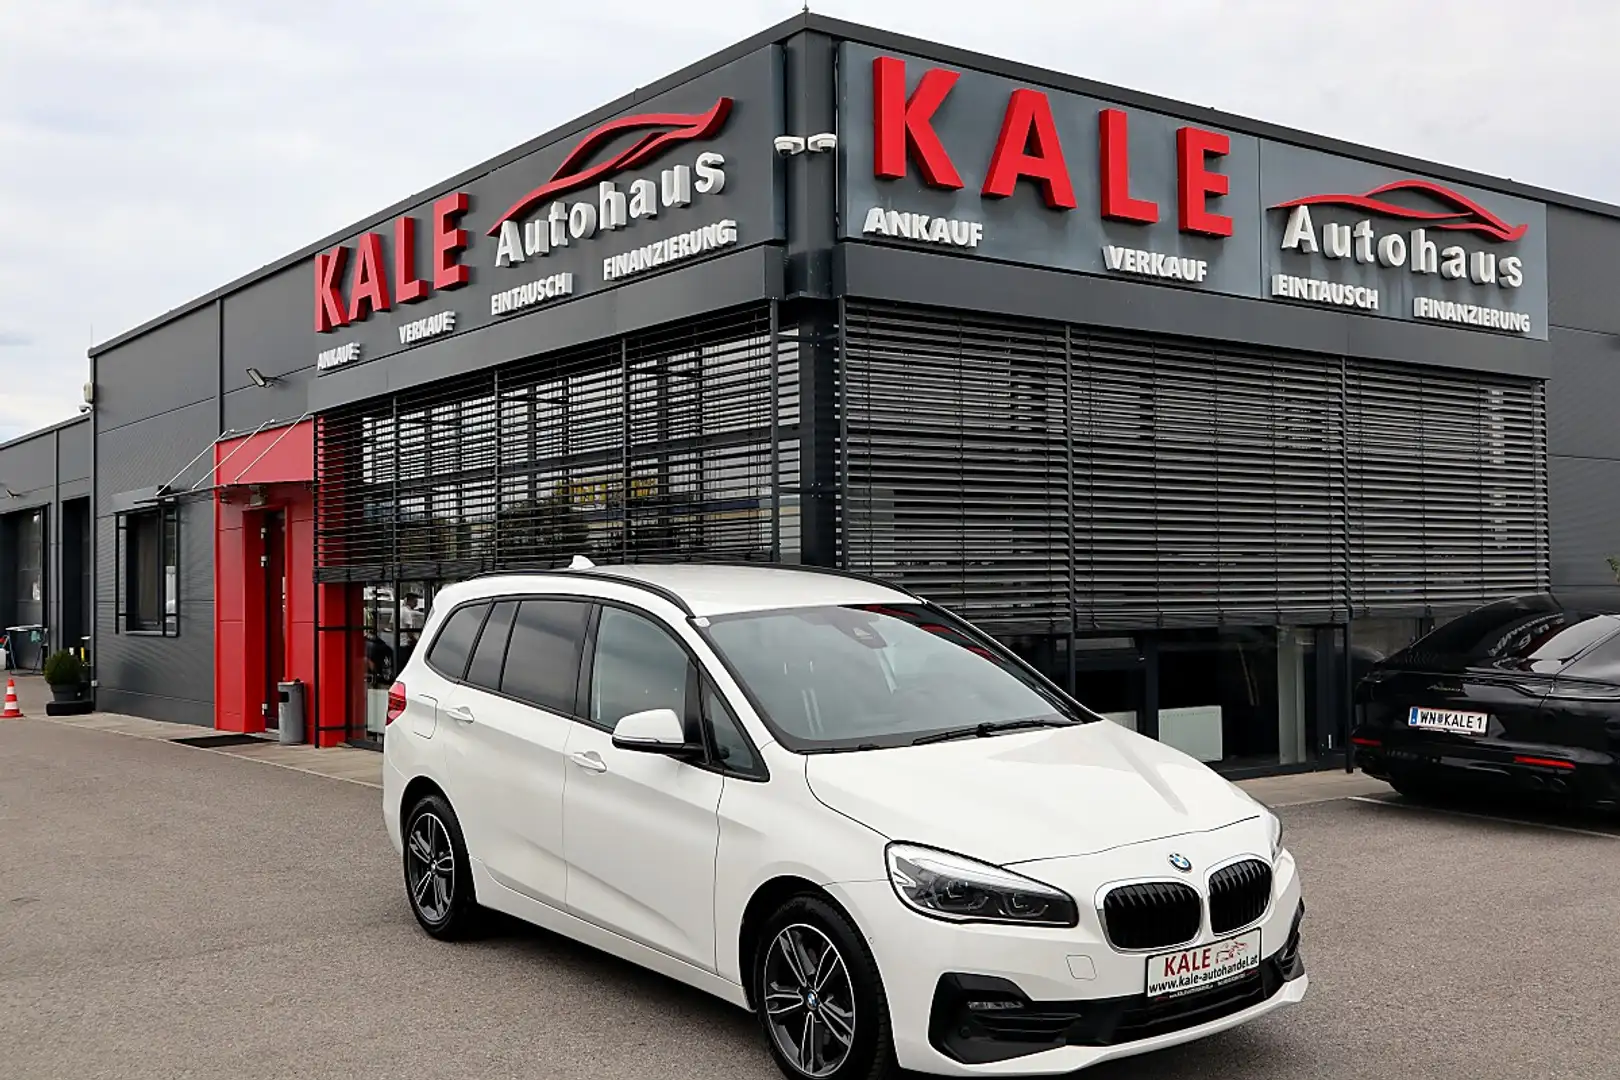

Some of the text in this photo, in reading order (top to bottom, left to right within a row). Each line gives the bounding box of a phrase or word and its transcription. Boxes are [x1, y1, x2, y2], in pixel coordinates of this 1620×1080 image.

[872, 56, 1233, 238] KALE
[495, 152, 726, 268] Autohaus
[862, 207, 983, 248] ANKAUF
[314, 192, 469, 333] KALE
[603, 219, 738, 281] FINANZIERUNG
[1102, 245, 1207, 282] VERKAUF
[1281, 205, 1523, 288] Autohaus
[491, 272, 573, 316] EINTAUSCH
[1271, 273, 1379, 310] EINTAUSCH
[399, 311, 456, 344] VERKAUF
[1413, 296, 1531, 333] FINANZIERUNG
[1420, 711, 1436, 724] WN
[1149, 954, 1258, 993] www.kale-autohandel.at
[1164, 948, 1211, 977] KALE
